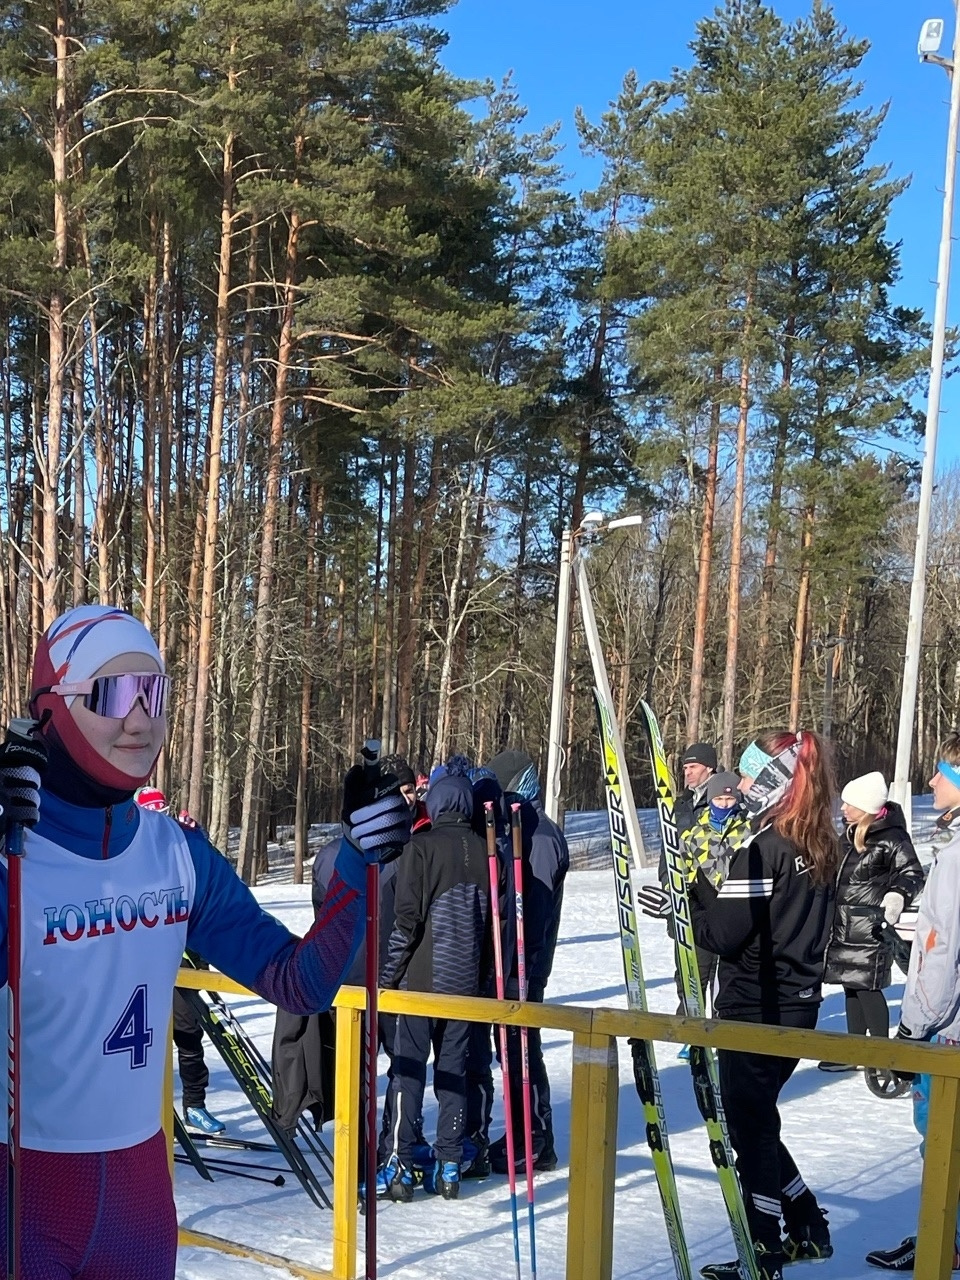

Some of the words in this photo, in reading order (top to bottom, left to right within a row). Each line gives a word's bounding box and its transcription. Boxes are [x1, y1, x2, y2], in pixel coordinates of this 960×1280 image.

[608, 790, 635, 935] FISCHER
[660, 801, 692, 951] FISCHER
[43, 886, 189, 945] ЮНОСТЬ
[103, 984, 153, 1070] 4
[222, 1032, 274, 1109] FISCHE
